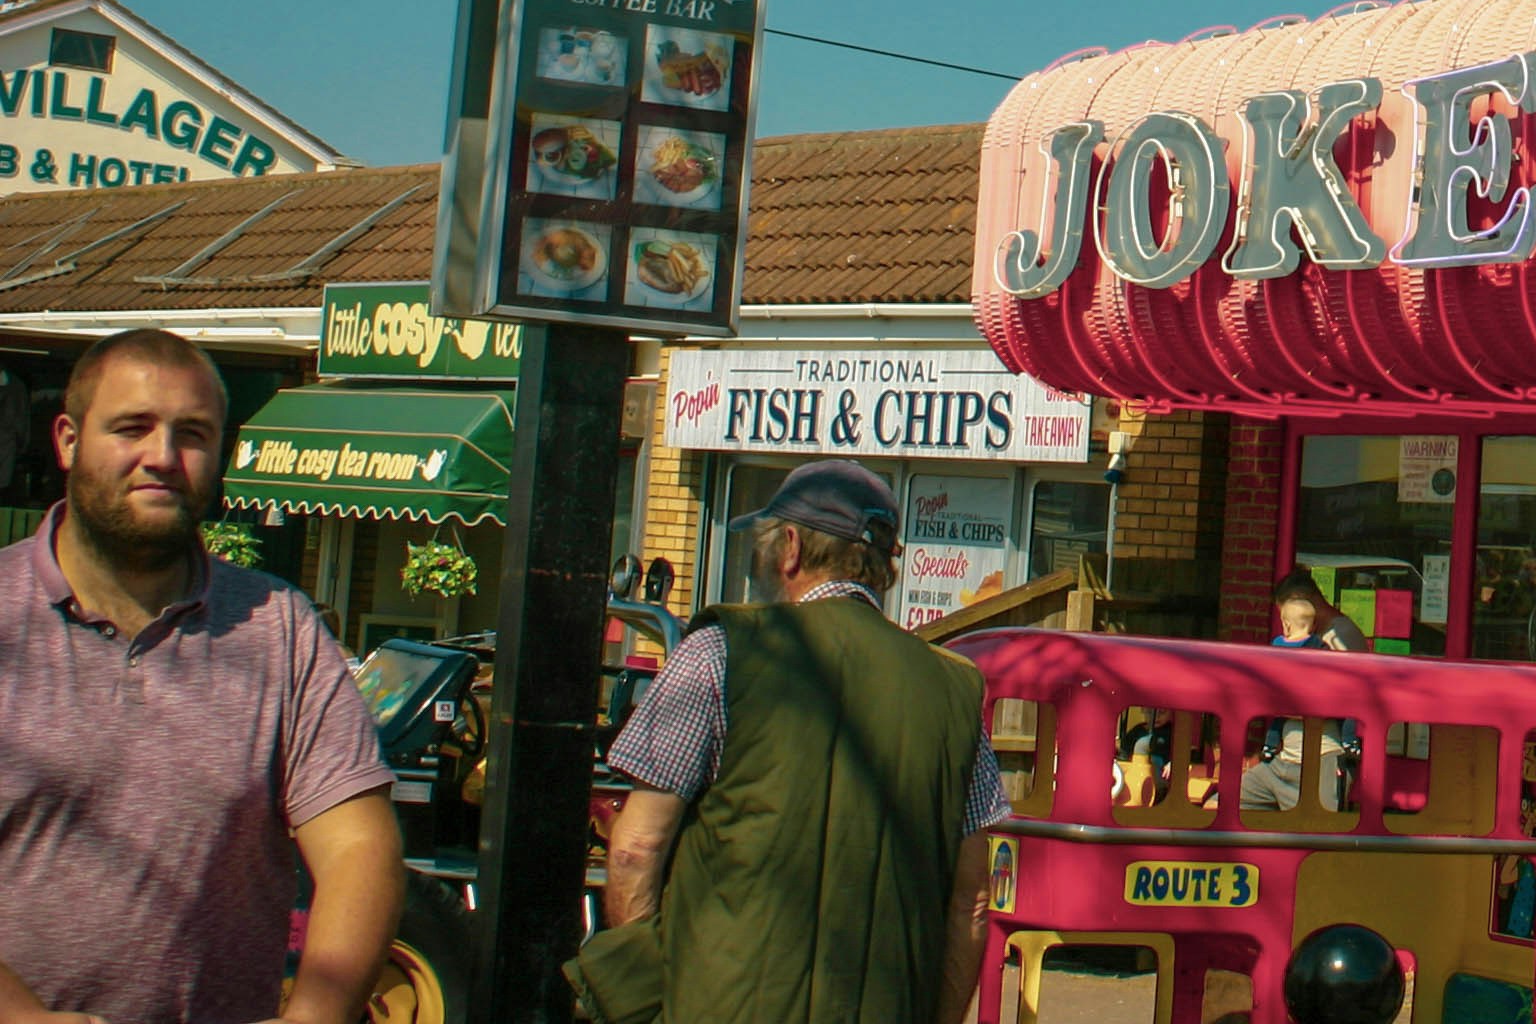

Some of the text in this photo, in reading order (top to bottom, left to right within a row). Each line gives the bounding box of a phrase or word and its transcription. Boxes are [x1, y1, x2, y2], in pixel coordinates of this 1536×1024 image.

[0, 69, 278, 176] VILLAGER
[30, 148, 58, 184] &
[327, 302, 373, 358] little
[373, 303, 445, 368] cosy
[796, 360, 939, 384] TRADITIONAL
[673, 371, 721, 428] Popin
[724, 388, 1016, 452] FISH & CHIPS
[1024, 416, 1083, 447] TAKEAWAY
[255, 440, 419, 481] little cosy tea room
[1403, 440, 1457, 457] WARNING
[914, 520, 1005, 543] FISH & CHIPS
[911, 546, 968, 584] Specials
[1132, 865, 1251, 906] ROUTE 3
